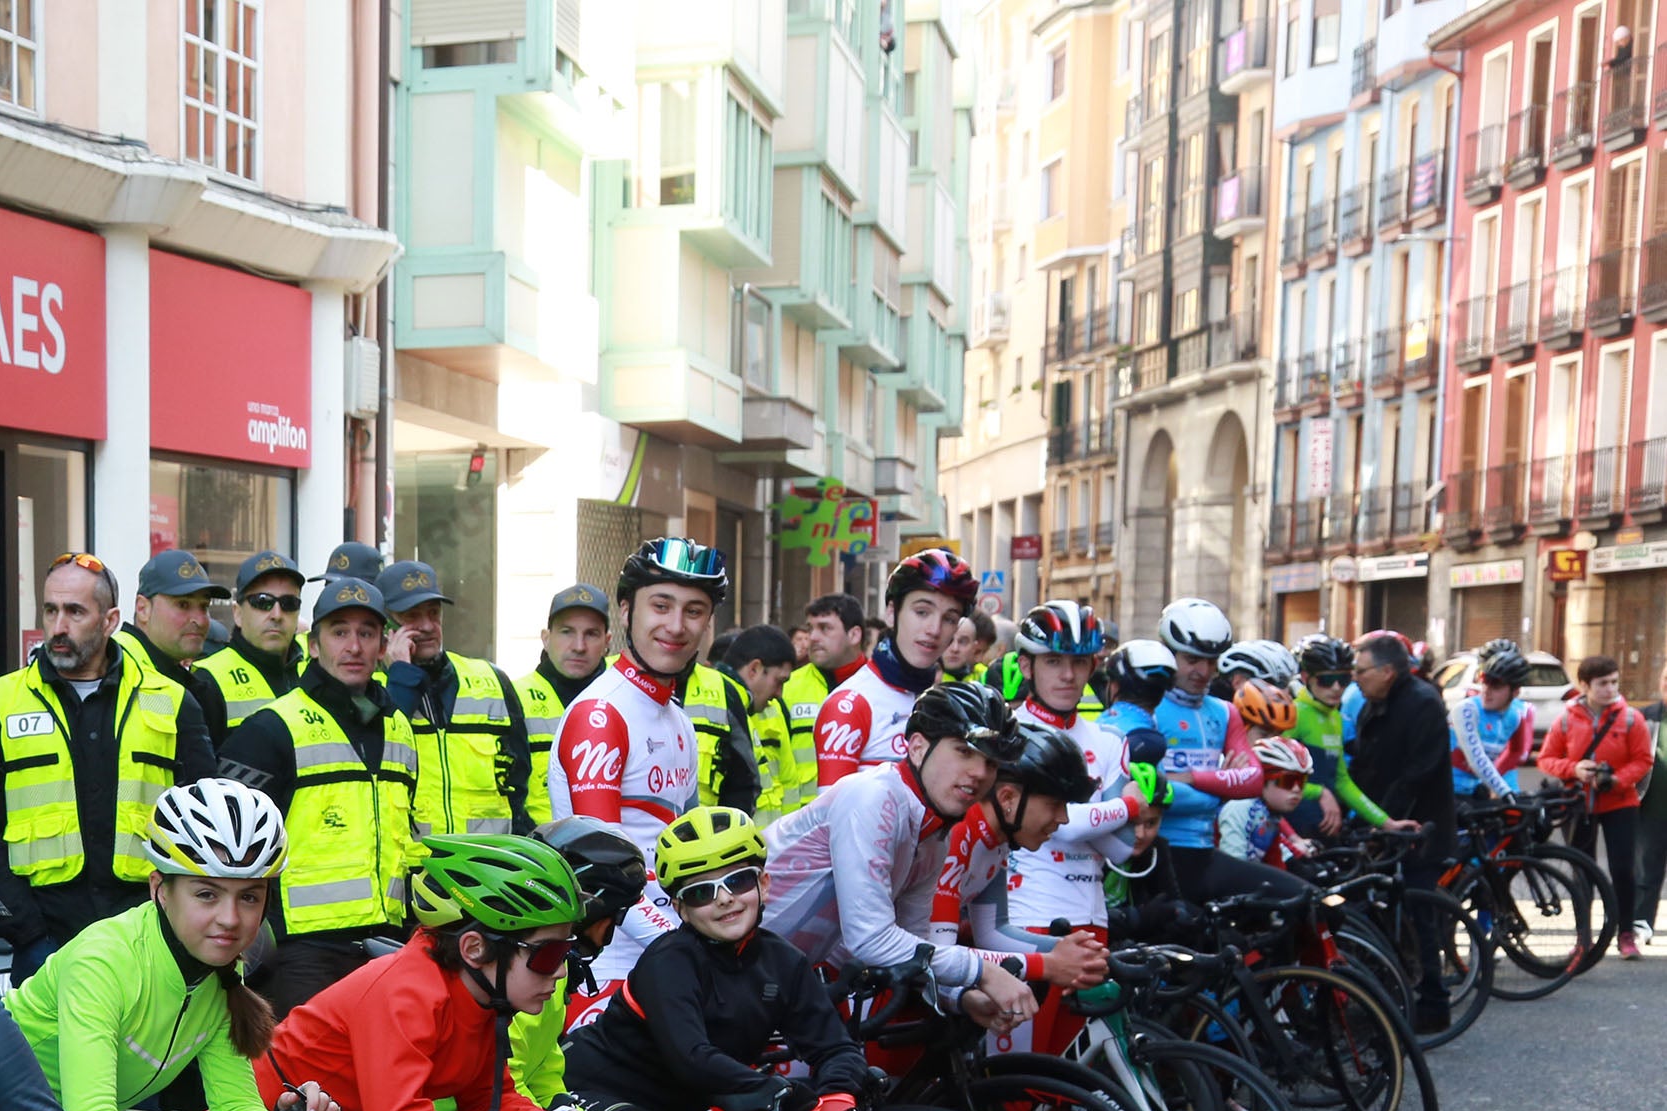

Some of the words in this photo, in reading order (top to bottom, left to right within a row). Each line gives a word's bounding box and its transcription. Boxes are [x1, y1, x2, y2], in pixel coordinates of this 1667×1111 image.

[248, 416, 308, 454] amplifon
[229, 667, 250, 685] 16
[633, 674, 657, 695] AMPO
[299, 708, 325, 726] 34
[795, 705, 812, 717] 04
[18, 719, 41, 733] 07
[665, 768, 691, 789] AMPO
